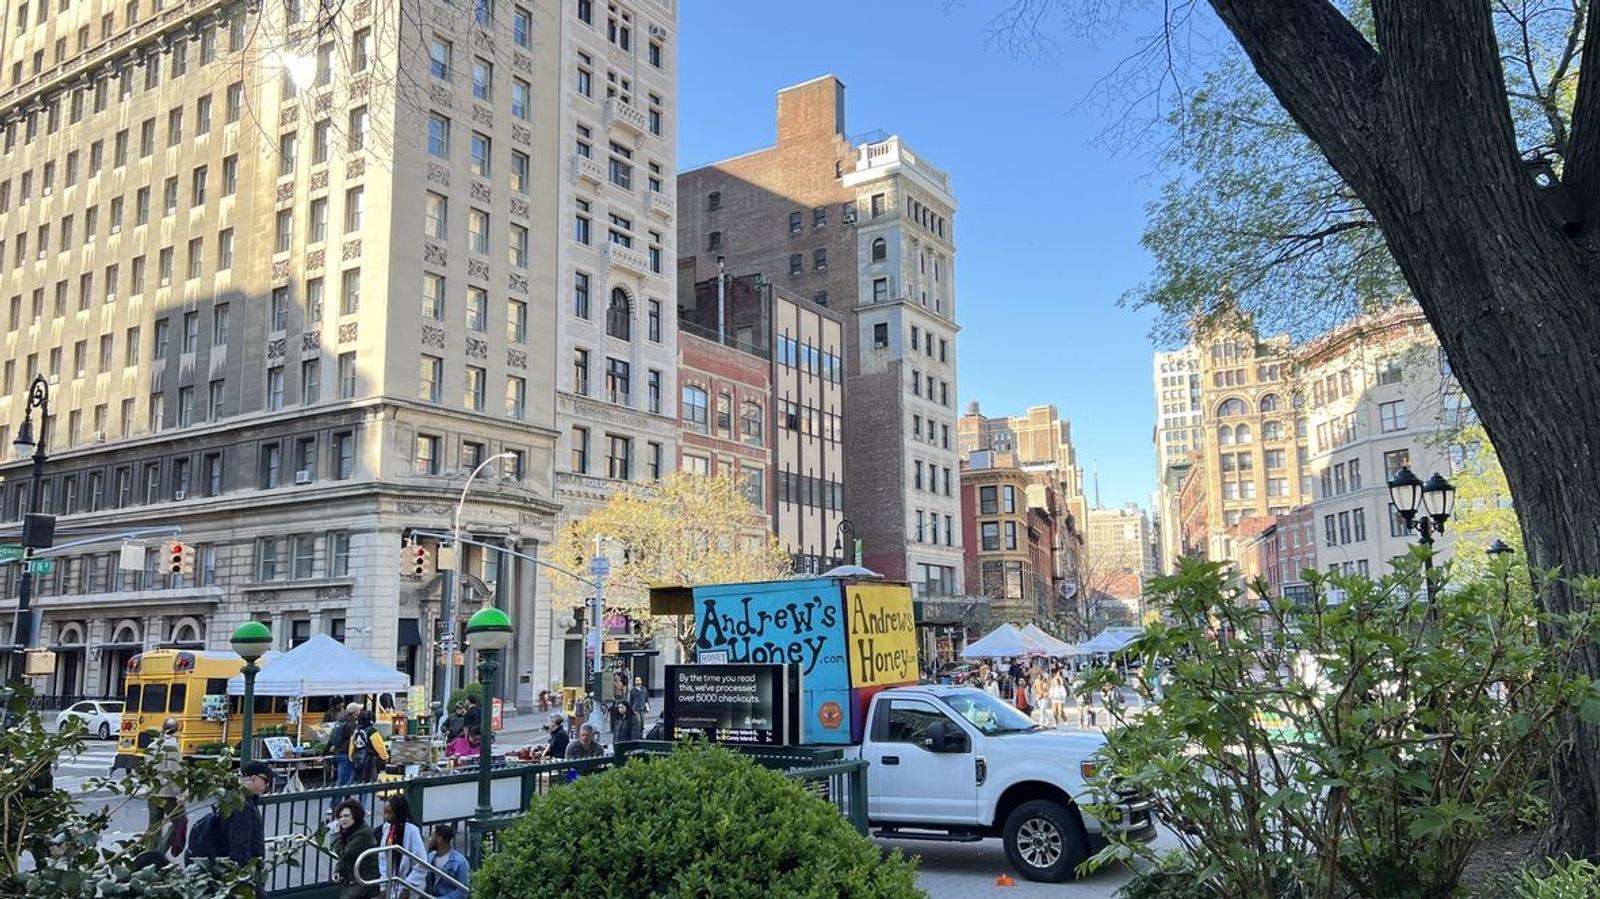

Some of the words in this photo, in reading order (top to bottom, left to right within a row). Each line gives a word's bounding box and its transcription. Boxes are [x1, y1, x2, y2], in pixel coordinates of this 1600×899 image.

[857, 639, 908, 683] Honey
[679, 673, 689, 684] By
[690, 674, 702, 683] the
[703, 674, 720, 683] time
[721, 676, 735, 685] you
[737, 674, 756, 683] read
[716, 685, 757, 694] processed
[679, 695, 695, 703] over
[718, 694, 760, 704] checkouts.
